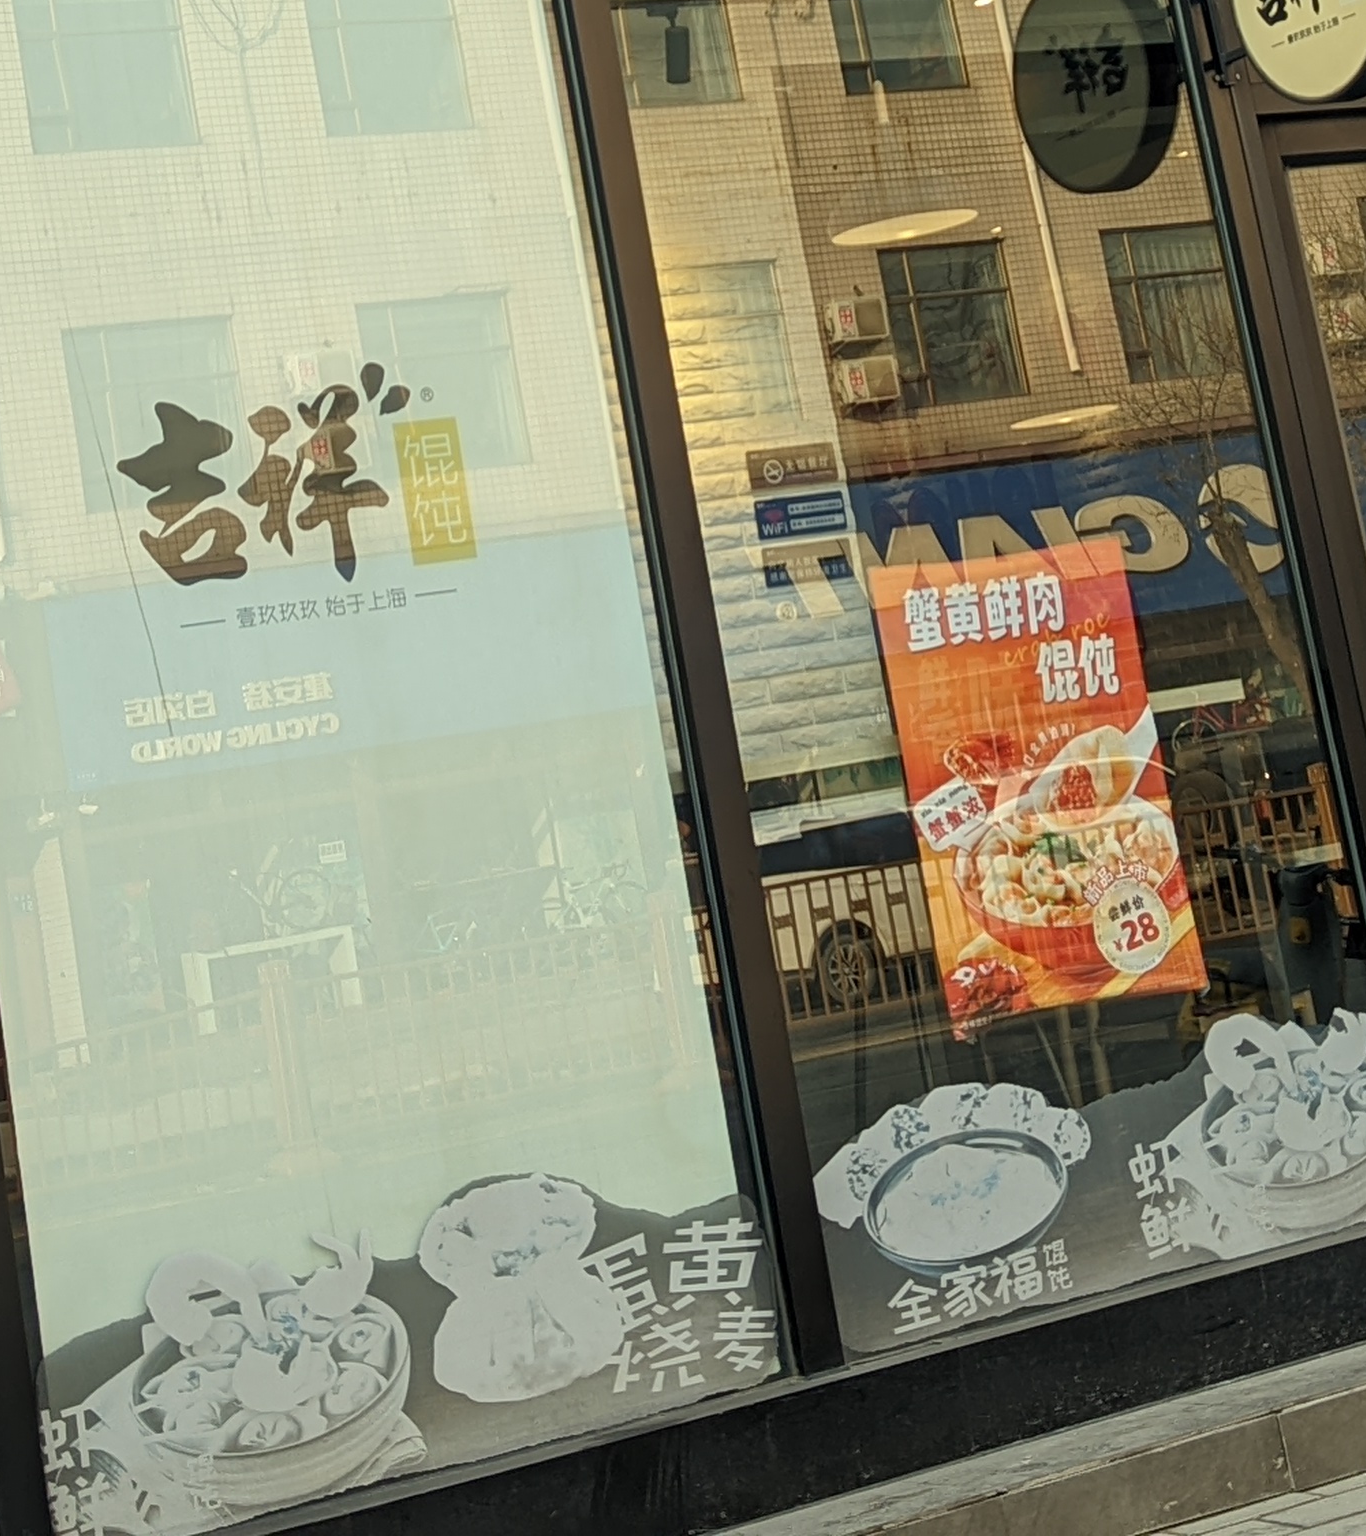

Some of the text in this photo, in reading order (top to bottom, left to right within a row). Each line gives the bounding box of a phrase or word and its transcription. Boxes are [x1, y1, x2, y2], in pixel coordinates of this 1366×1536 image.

[116, 362, 411, 585] 吉祥
[402, 432, 468, 549] 馄饨
[761, 522, 789, 538] WiFi
[235, 587, 408, 629] 壹玖玖玖 始于上海
[903, 571, 1067, 653] 蟹黄鲜肉
[1033, 632, 1121, 702] 馄饨
[1082, 859, 1149, 906] 新品上市
[1112, 911, 1161, 953] ¥28
[887, 1244, 1046, 1336] 全家福
[1041, 1238, 1075, 1295] 馄饨
